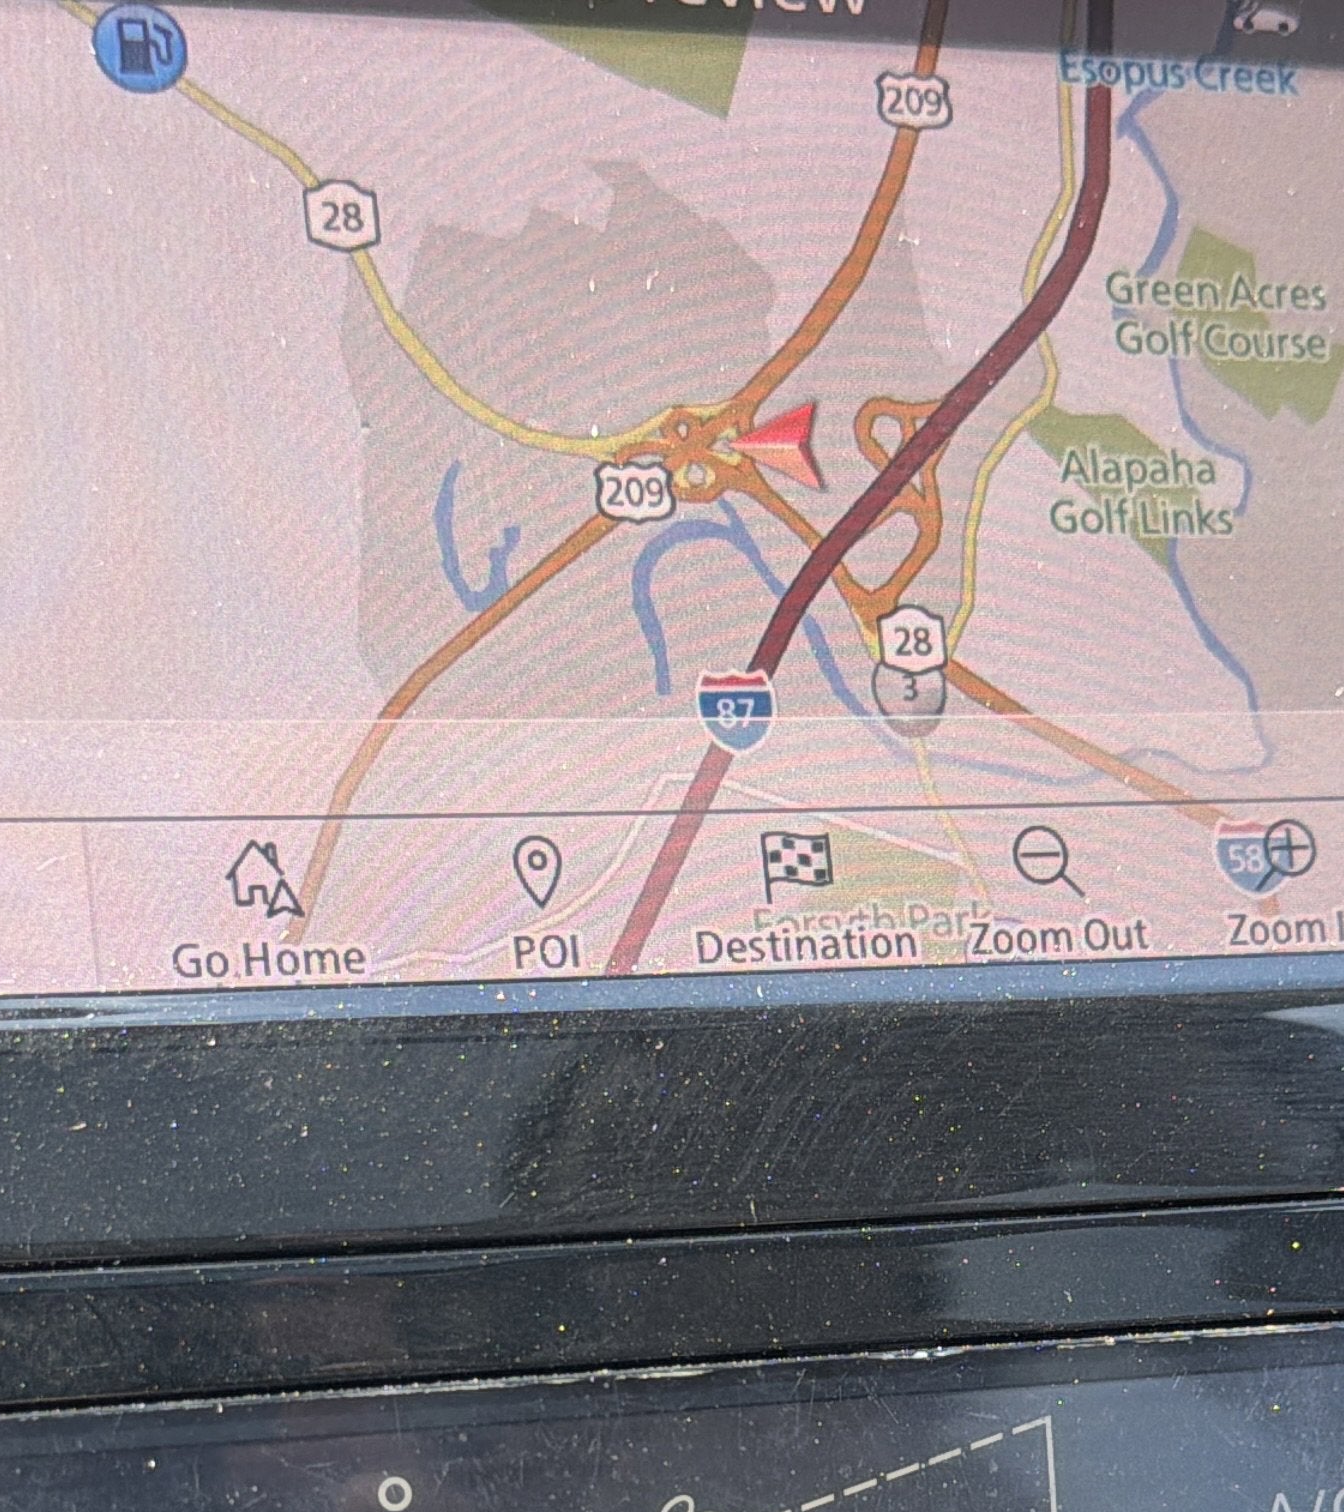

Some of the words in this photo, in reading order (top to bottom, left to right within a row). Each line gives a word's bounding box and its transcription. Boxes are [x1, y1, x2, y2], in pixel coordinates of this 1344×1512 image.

[1060, 50, 1186, 95] Esopus
[1195, 55, 1298, 97] Creek
[885, 86, 944, 117] 209
[320, 201, 364, 233] 28
[1106, 272, 1219, 308] Green
[1232, 277, 1327, 311] Acres
[1115, 320, 1192, 356] Golf
[1201, 324, 1327, 360] Course
[1061, 449, 1217, 494] Alapaha
[605, 475, 664, 509] 209
[1050, 501, 1128, 536] Golf
[1139, 503, 1234, 537] Links
[894, 626, 933, 656] 28
[716, 700, 756, 729] 87
[697, 926, 918, 964] Destination
[971, 922, 1073, 955] Zoom
[1084, 919, 1148, 951] Out
[1228, 914, 1330, 946] Zoom
[172, 943, 230, 978] Go
[244, 942, 366, 977] Home
[514, 936, 580, 969] POI
